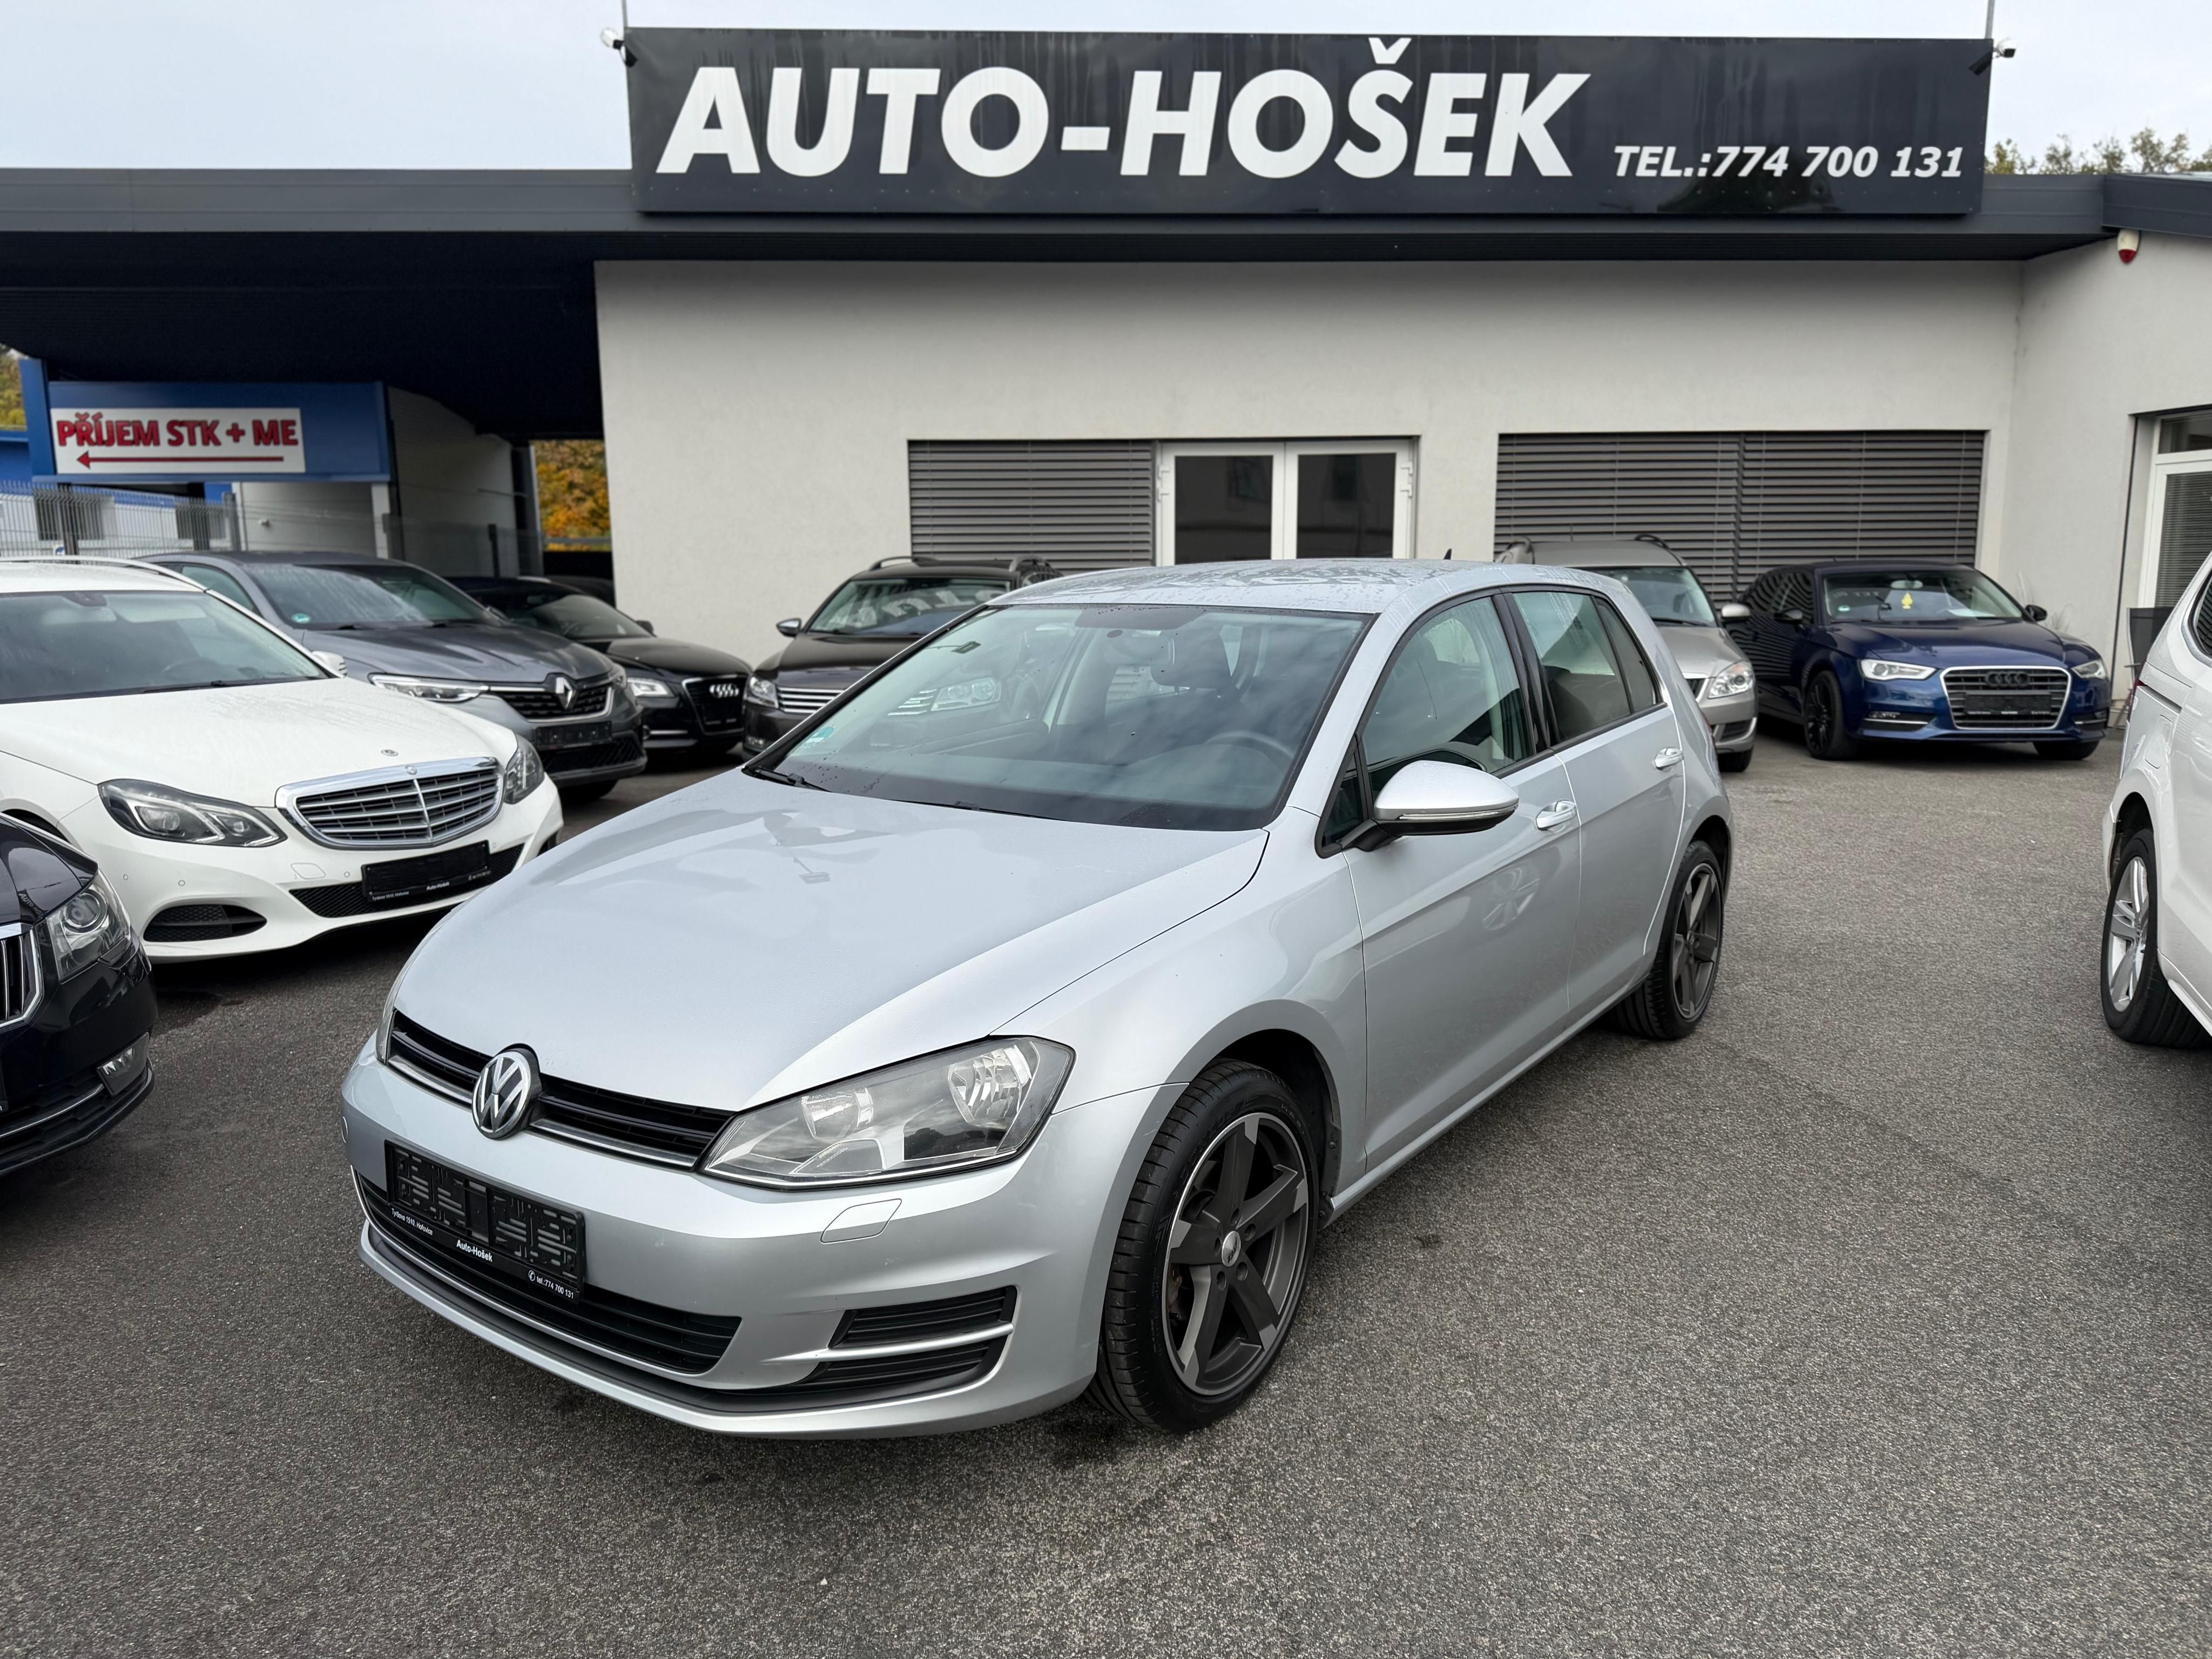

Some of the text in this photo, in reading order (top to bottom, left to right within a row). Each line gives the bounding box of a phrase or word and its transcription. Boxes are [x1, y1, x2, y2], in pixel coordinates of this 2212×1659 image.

[655, 37, 1591, 179] AUTO-HOŠEK
[1614, 145, 1963, 178] TEL.:774 700 131
[56, 412, 160, 447] PŘÍJEM
[167, 419, 222, 447] STK
[252, 419, 299, 446] ME
[456, 1239, 493, 1263] Auto-Hošek
[555, 1284, 564, 1294] 700
[565, 1289, 574, 1299] 131
